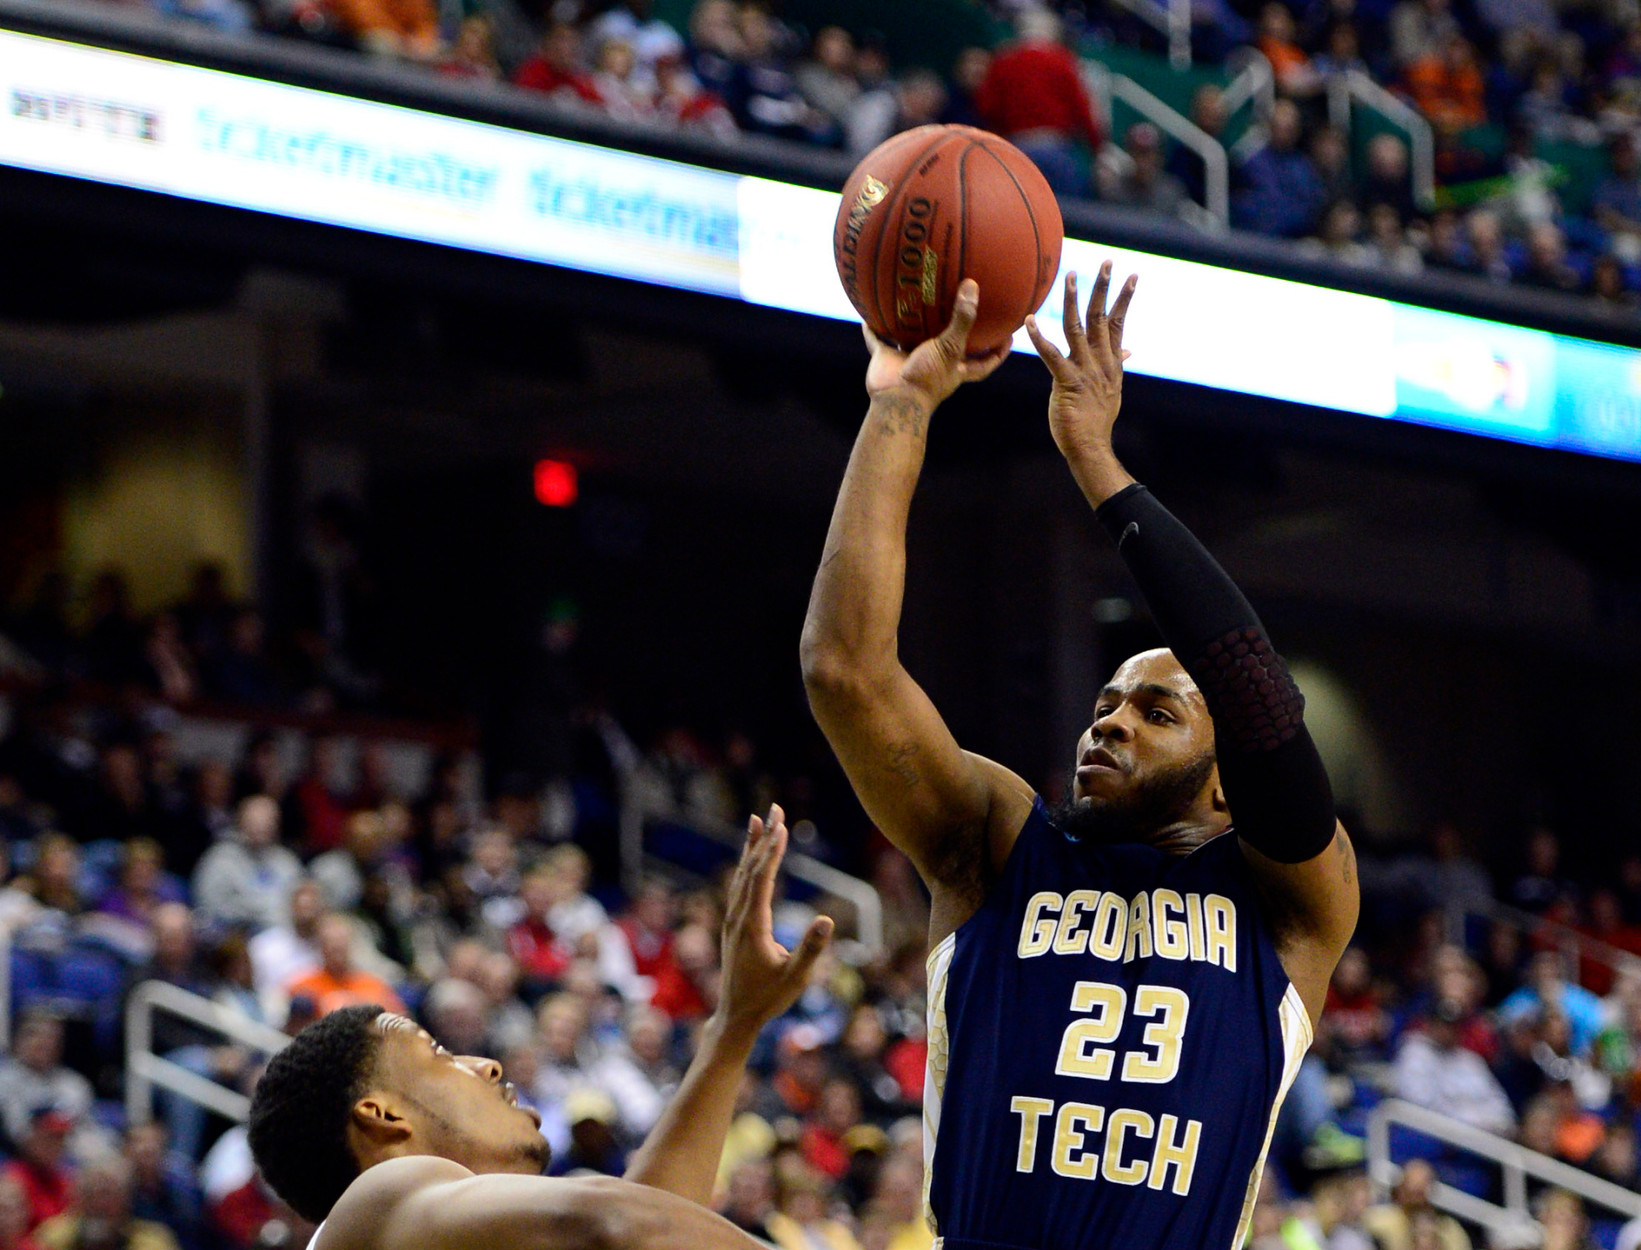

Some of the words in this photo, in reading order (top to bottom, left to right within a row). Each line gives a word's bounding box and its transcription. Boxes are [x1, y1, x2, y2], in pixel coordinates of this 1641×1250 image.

[1017, 887, 1237, 973] GEORGIA
[1055, 980, 1190, 1084] 23
[1010, 1095, 1203, 1197] TECH
